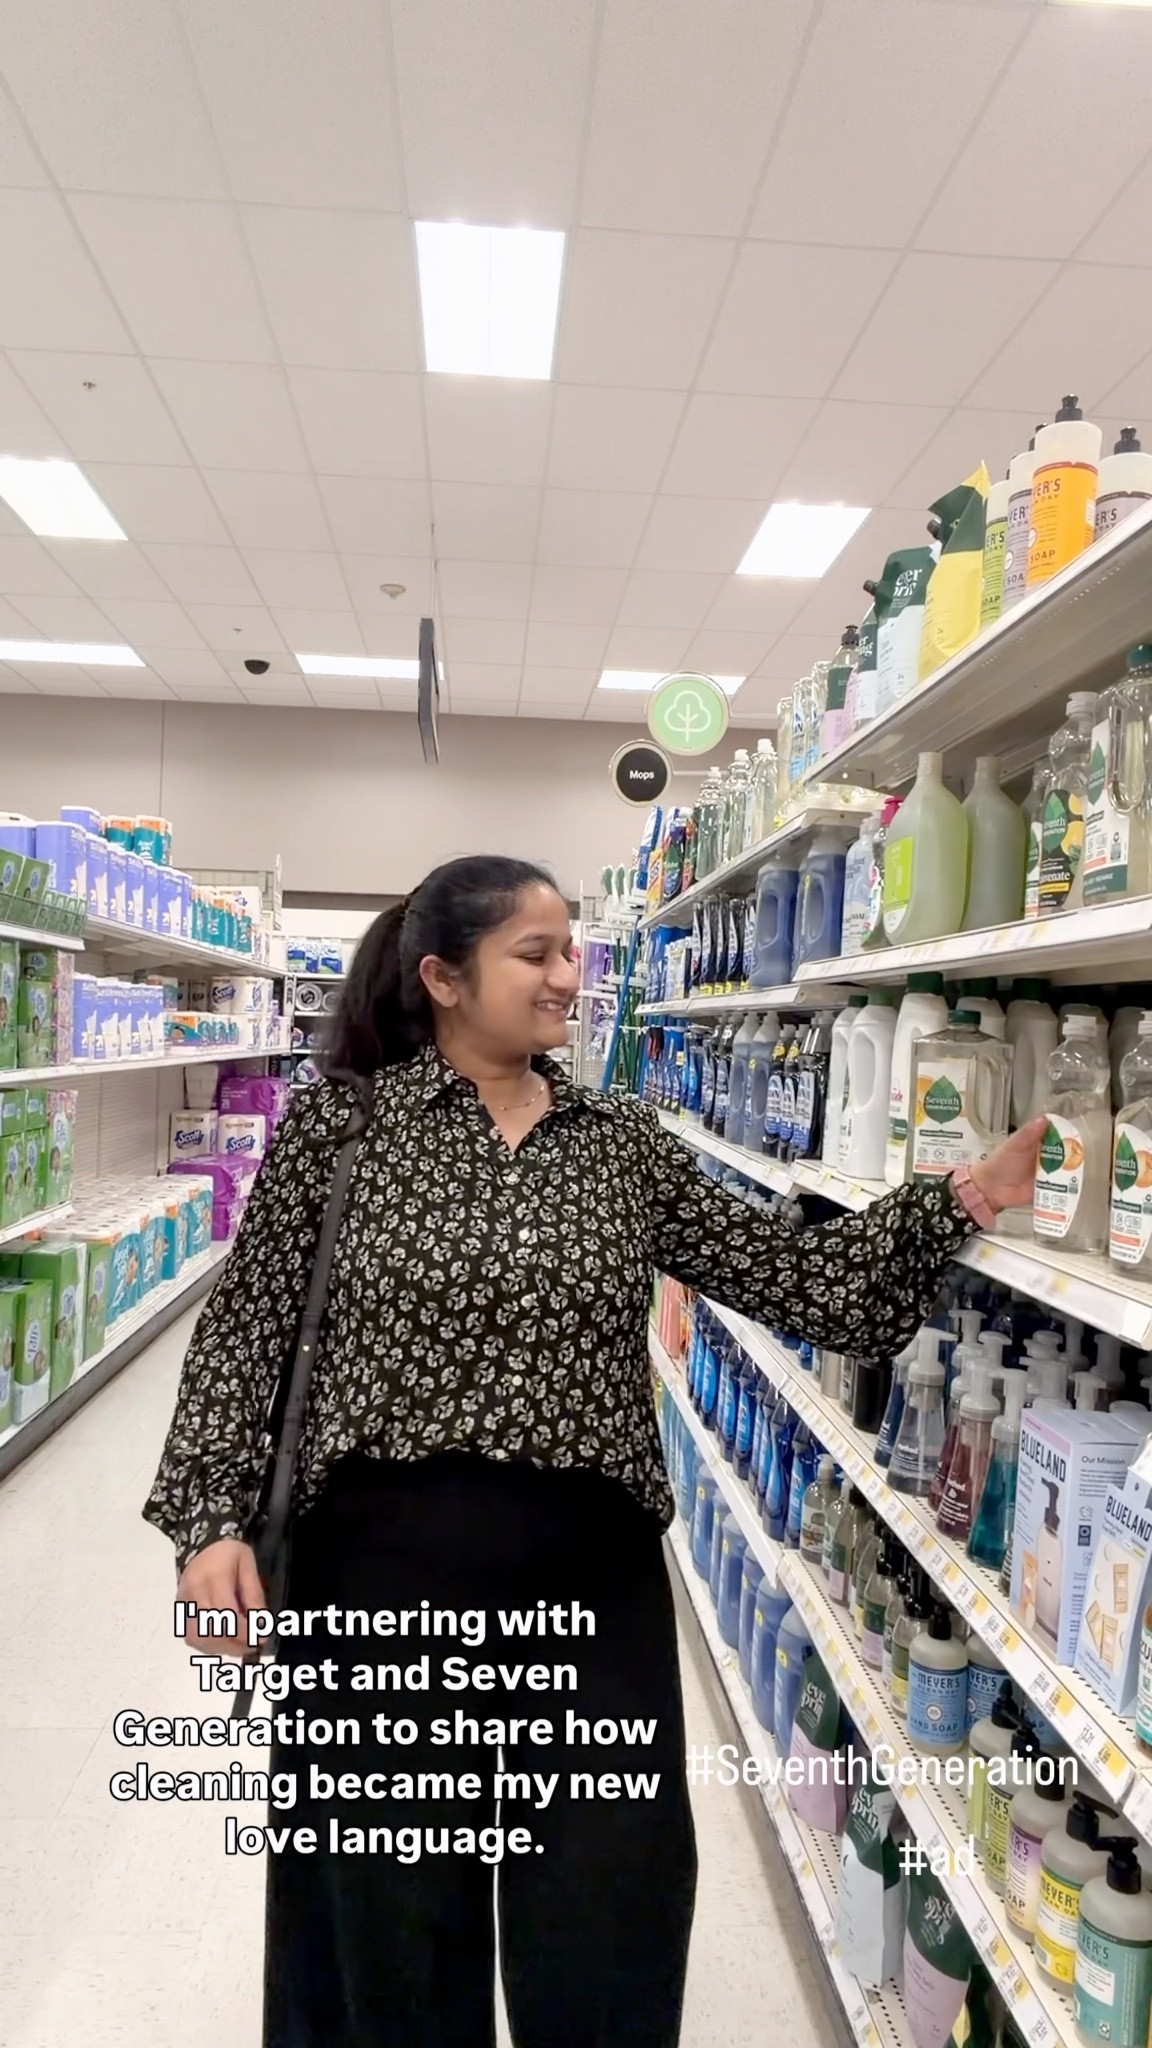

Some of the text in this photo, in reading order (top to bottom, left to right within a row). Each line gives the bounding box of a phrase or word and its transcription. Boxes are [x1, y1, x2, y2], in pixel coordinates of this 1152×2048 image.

[629, 770, 655, 780] Mops
[926, 1096, 960, 1106] Seventh
[178, 1130, 201, 1144] Scott
[230, 1135, 253, 1151] Scott
[1020, 1430, 1067, 1483] BLUELAND
[1081, 1456, 1126, 1465] Our Mission
[1105, 1495, 1152, 1542] BLUELAND
[917, 1673, 961, 1689] MEYER'S
